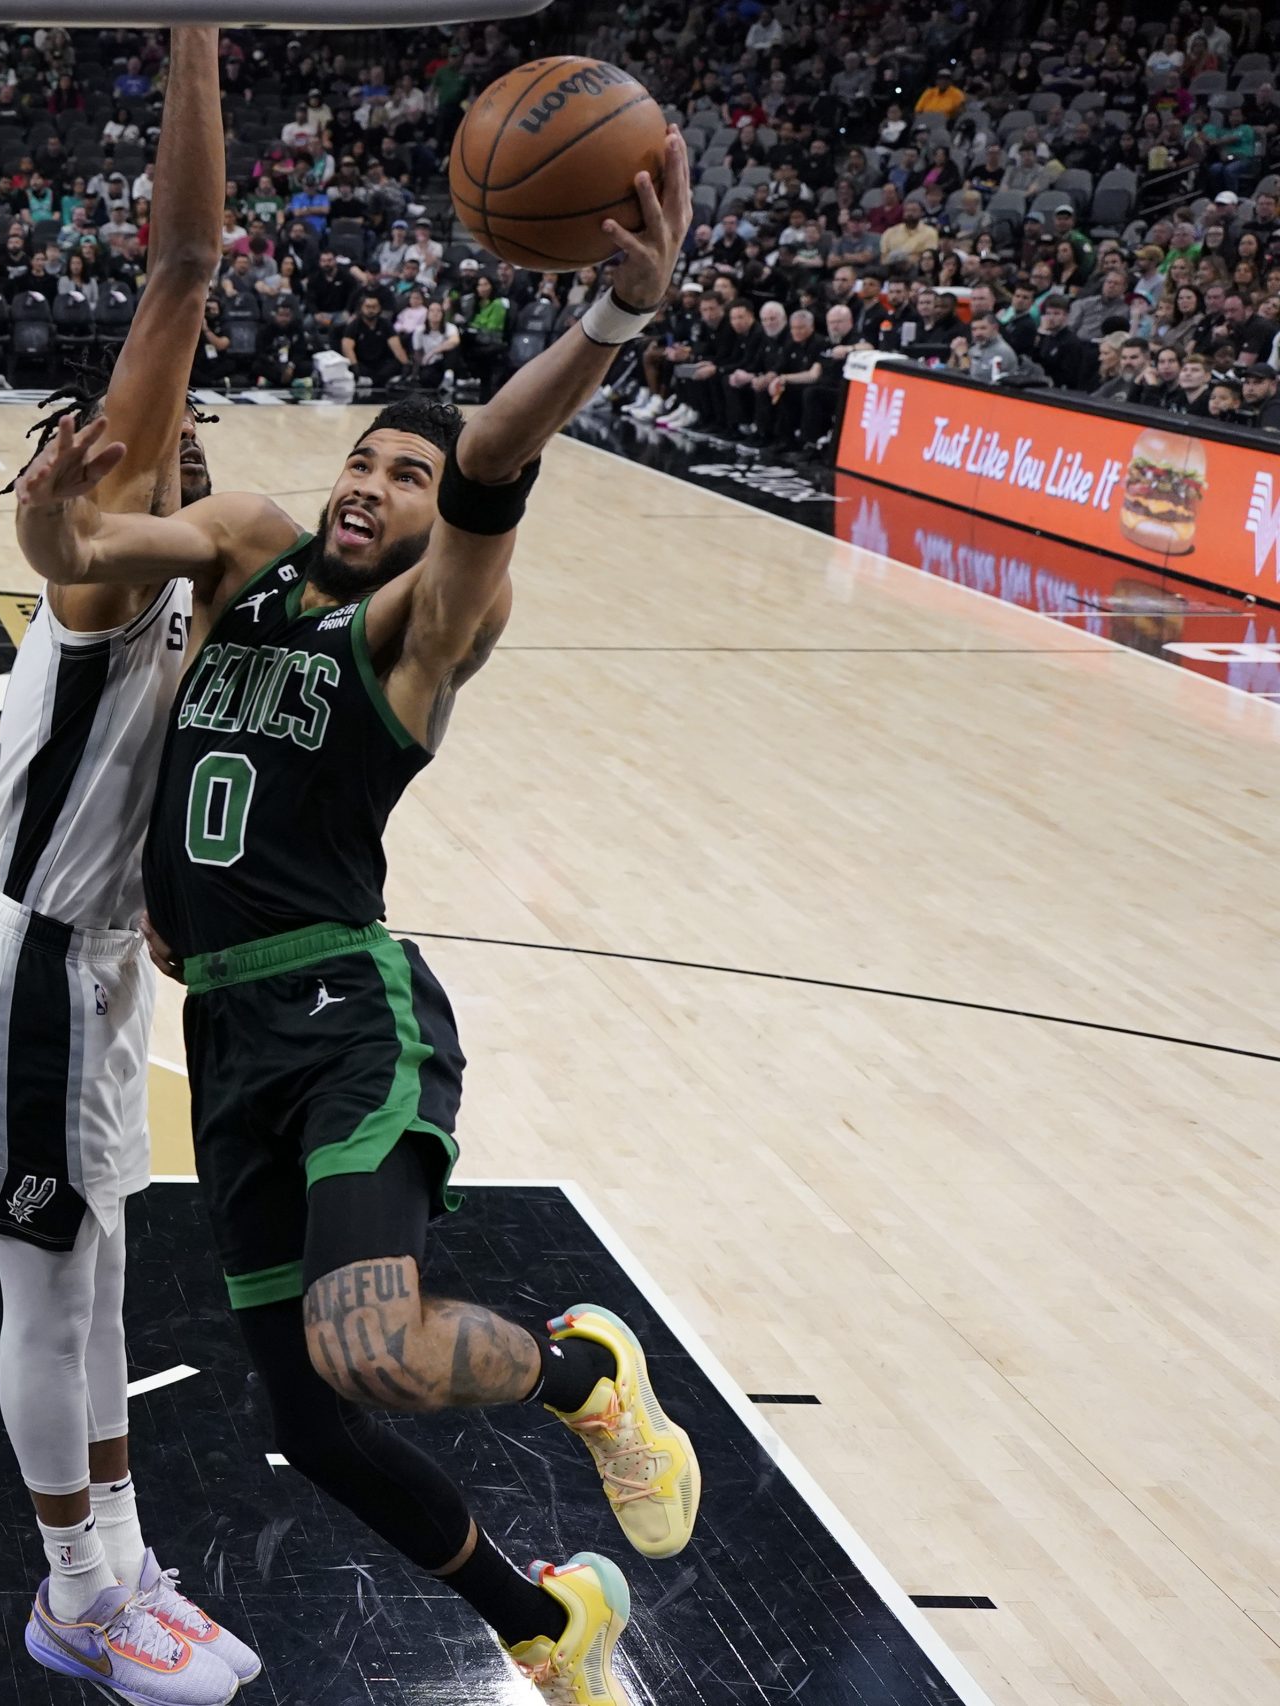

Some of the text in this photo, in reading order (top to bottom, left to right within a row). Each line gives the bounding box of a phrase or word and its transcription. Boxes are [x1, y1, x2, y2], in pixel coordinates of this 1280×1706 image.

[923, 416, 1122, 512] Just Like You Like It
[278, 563, 298, 582] 6
[317, 614, 353, 631] PRINT
[177, 643, 341, 751] CELTICS
[185, 751, 257, 867] 0
